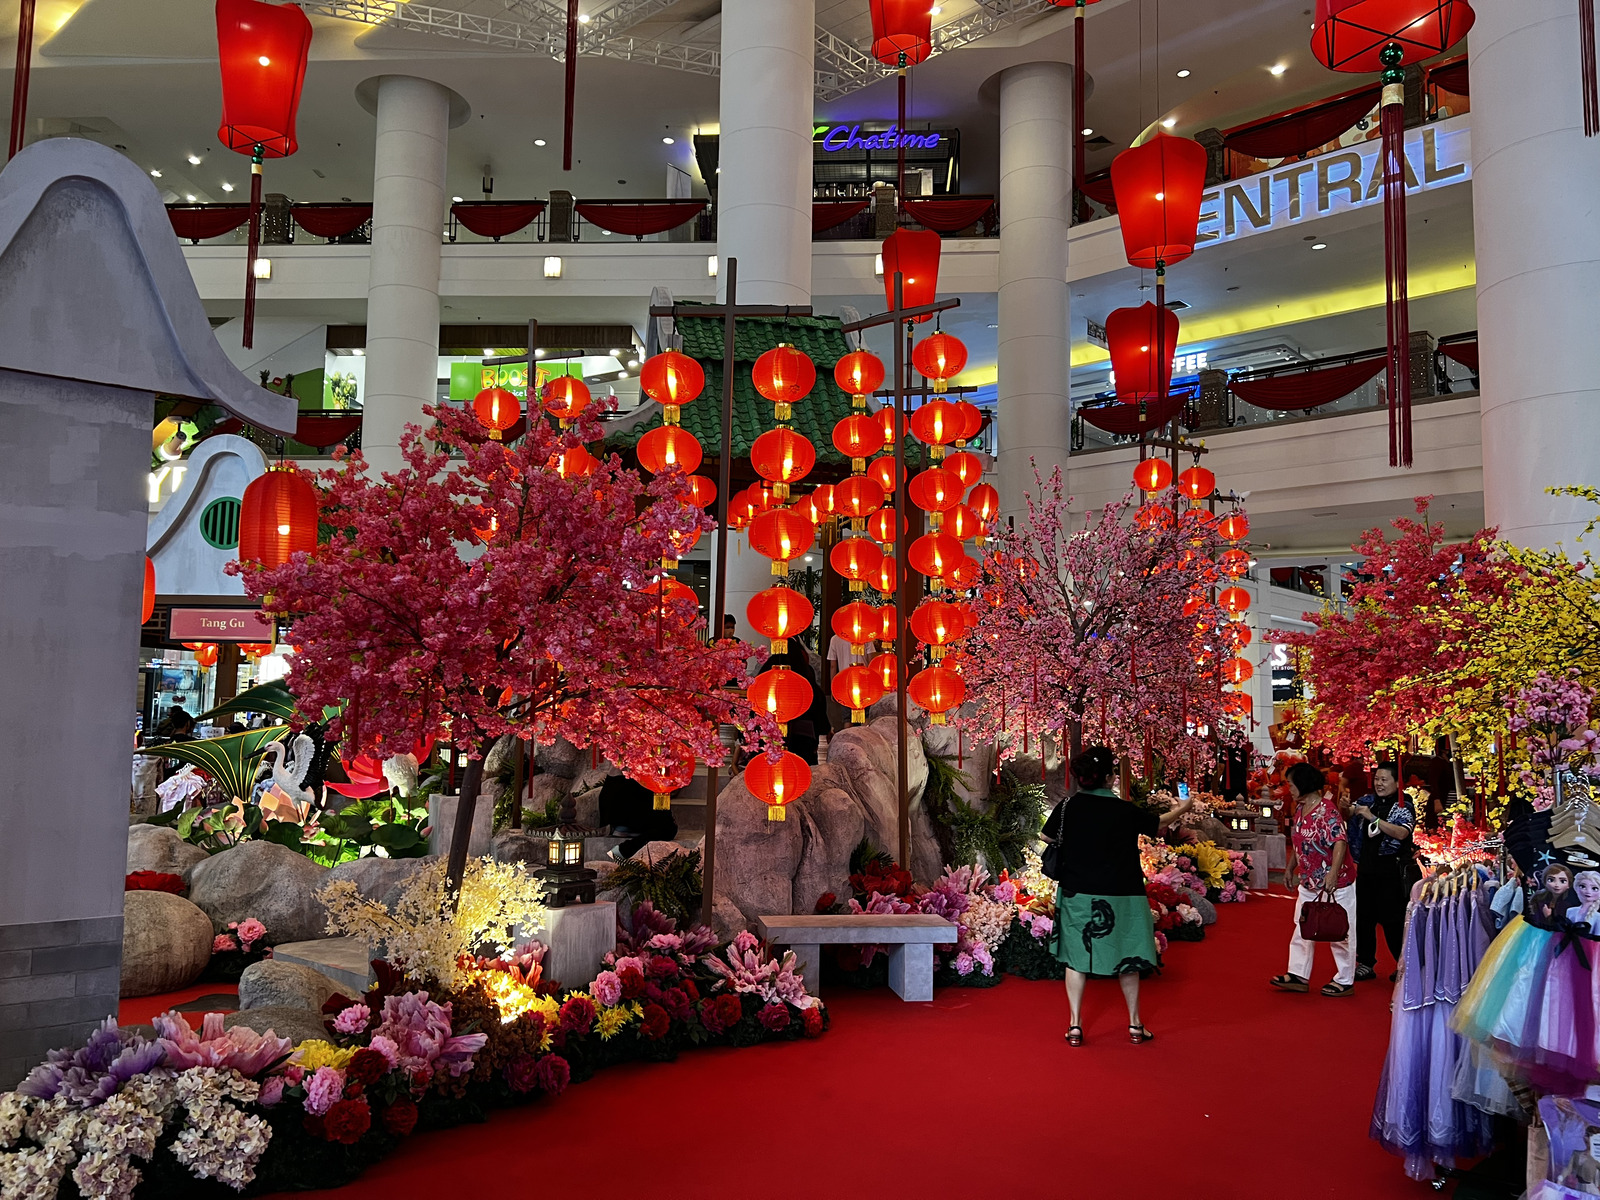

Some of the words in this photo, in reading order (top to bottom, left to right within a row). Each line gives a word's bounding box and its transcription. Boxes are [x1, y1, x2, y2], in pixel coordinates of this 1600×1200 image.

[823, 125, 940, 152] Chatime
[200, 617, 227, 630] Tang
[229, 618, 245, 628] Gu
